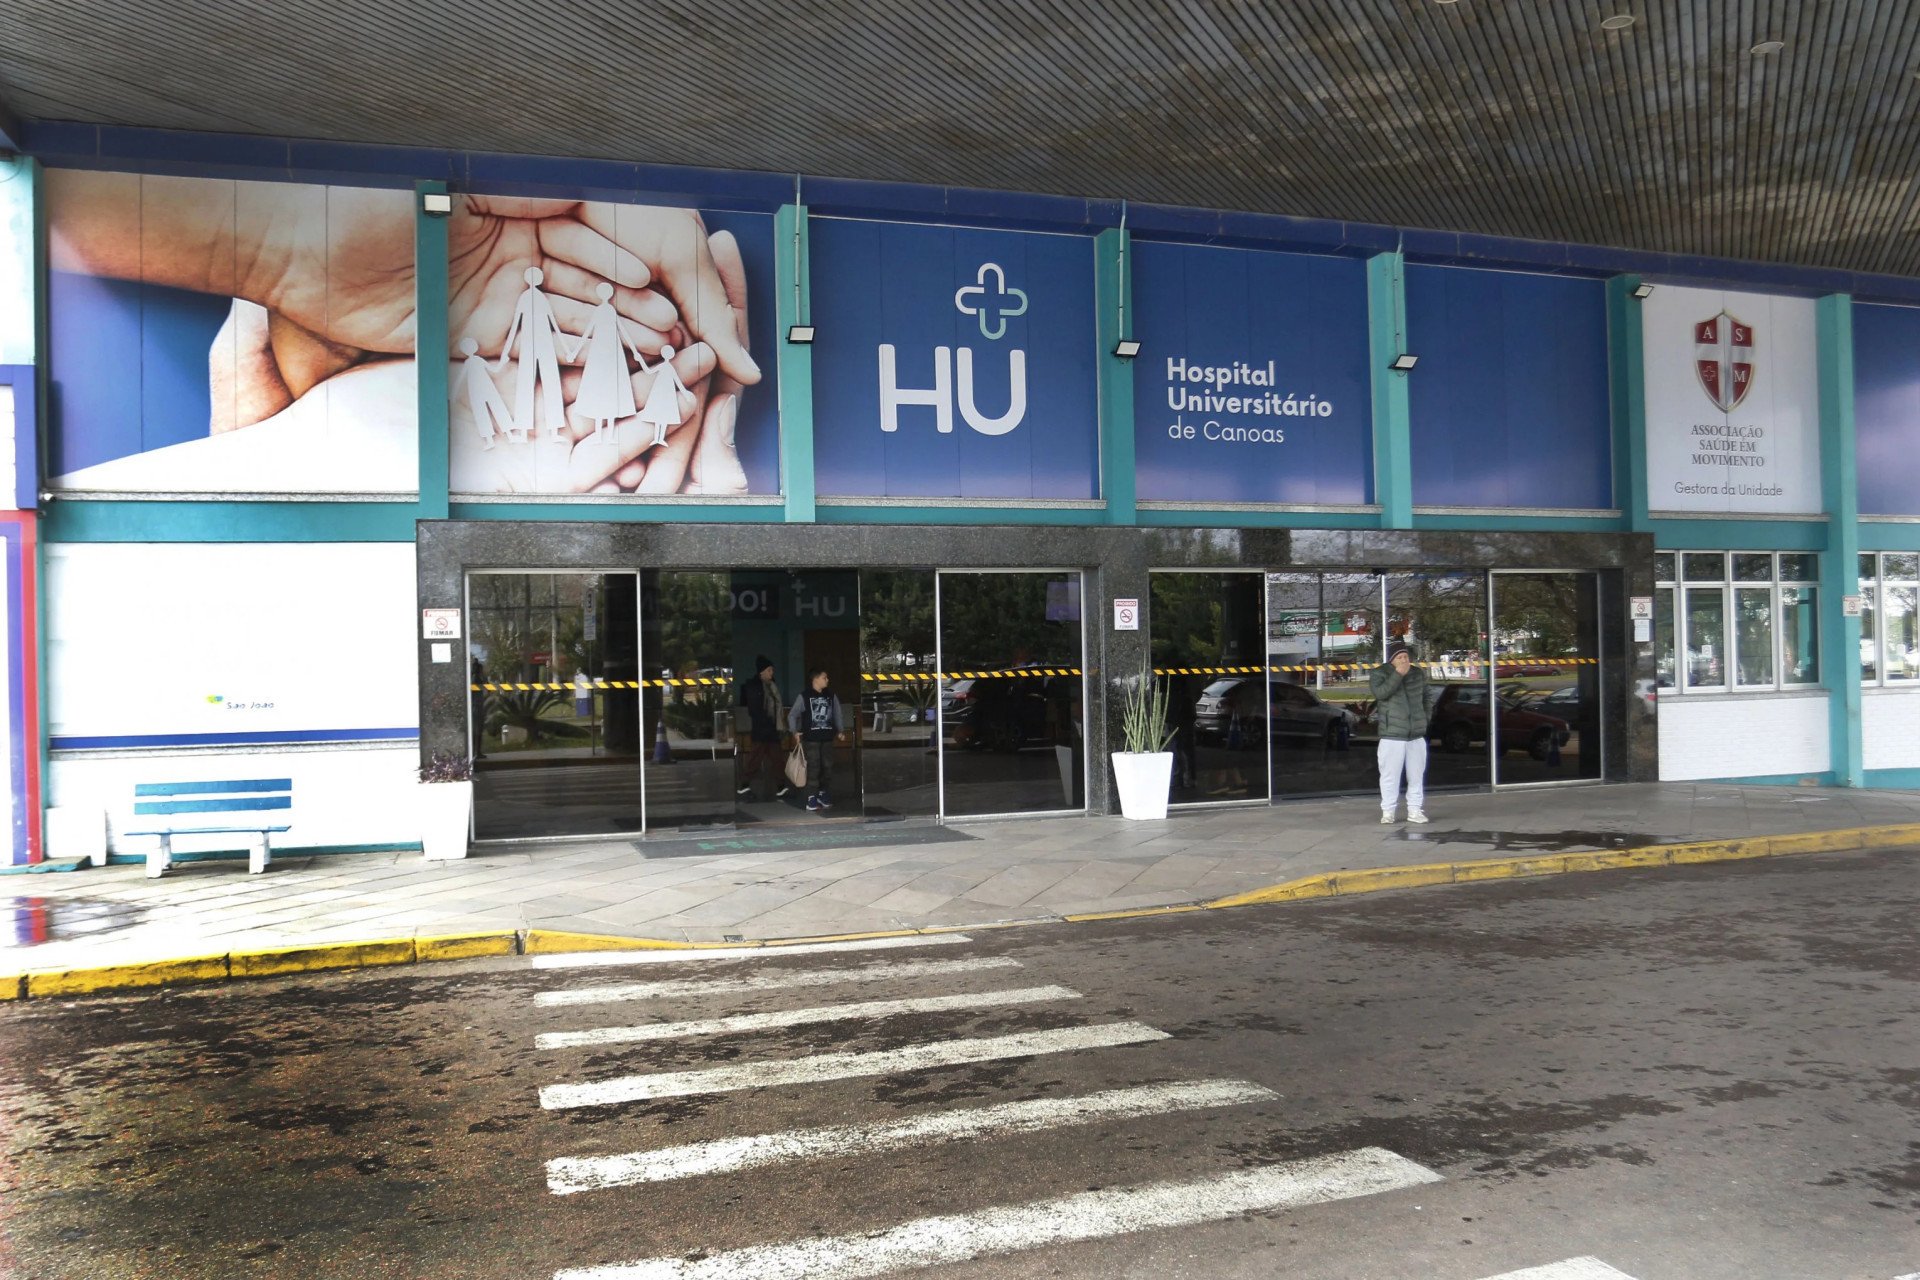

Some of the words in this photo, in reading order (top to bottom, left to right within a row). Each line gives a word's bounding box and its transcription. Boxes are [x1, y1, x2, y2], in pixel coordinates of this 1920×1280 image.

[1702, 326, 1713, 339] A
[1735, 328, 1743, 342] S
[1167, 357, 1276, 392] Hospital
[1734, 370, 1746, 383] M
[879, 344, 1027, 436] HU
[1168, 386, 1333, 418] Universitário
[1168, 415, 1196, 440] de
[1203, 420, 1285, 443] Canoas
[1691, 424, 1764, 441] ASSOCIAÇÃO
[1699, 438, 1737, 452] SAÚDE
[1739, 441, 1756, 452] EM
[1691, 453, 1765, 467] MOVIMENTO
[1675, 481, 1718, 495] Gestora
[1721, 481, 1736, 495] da
[1739, 482, 1783, 496] Unidade
[795, 596, 846, 617] HU
